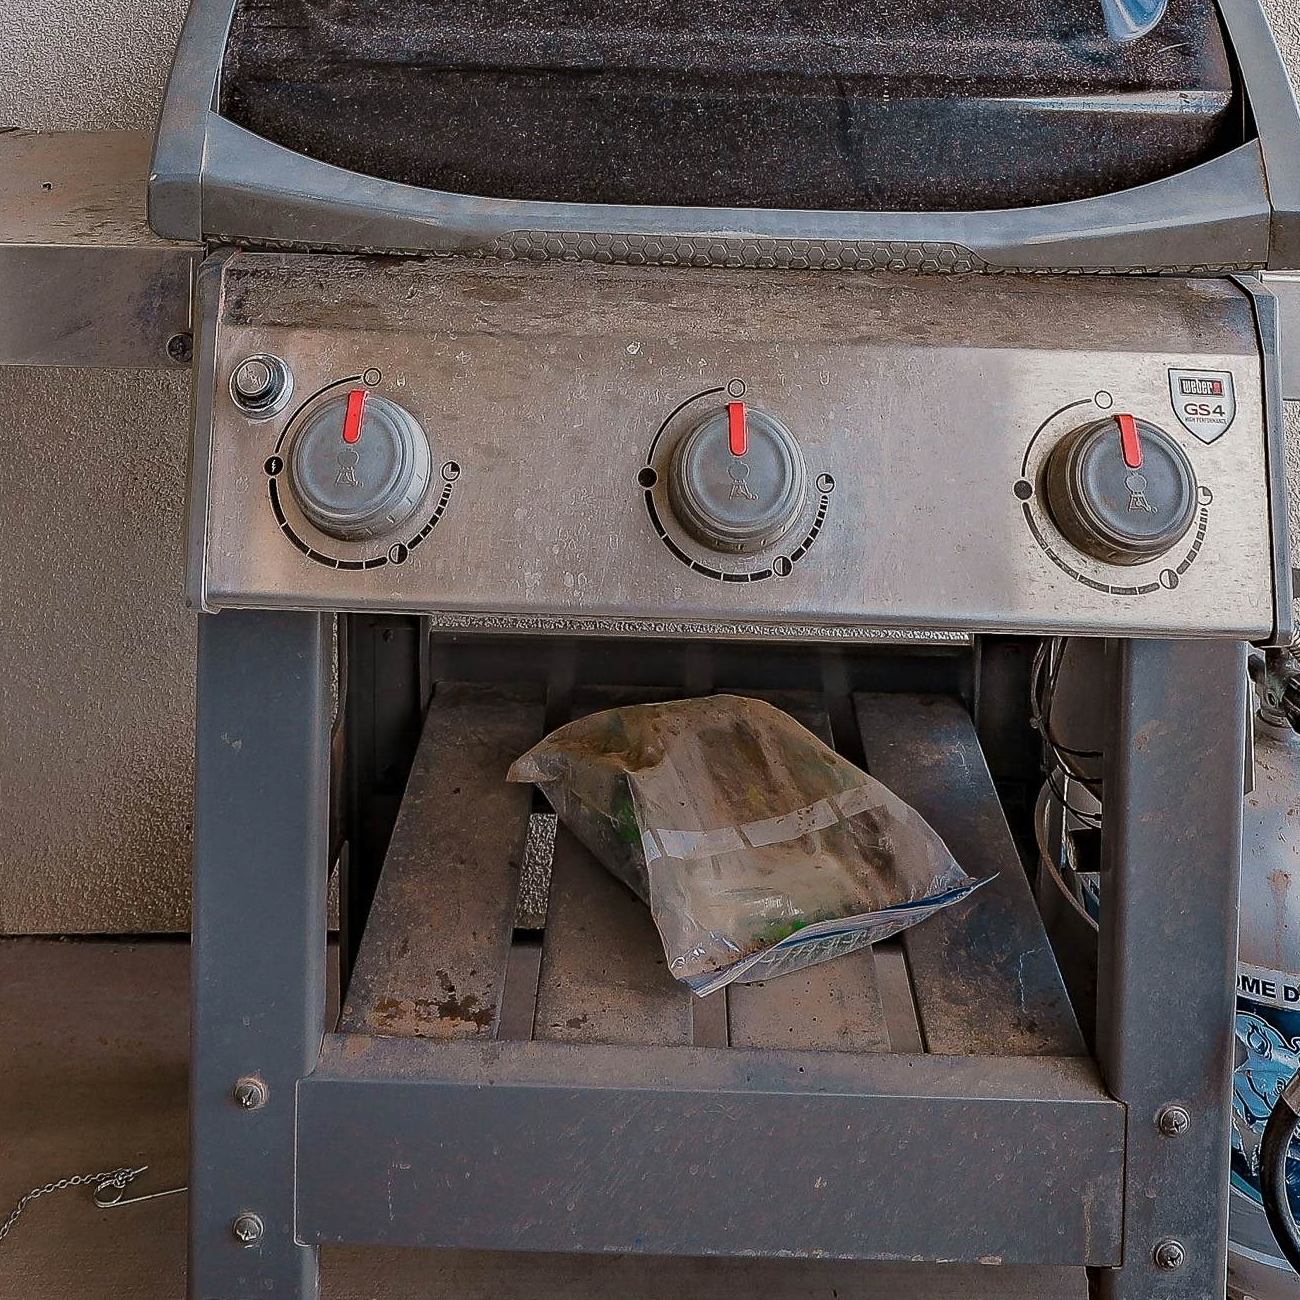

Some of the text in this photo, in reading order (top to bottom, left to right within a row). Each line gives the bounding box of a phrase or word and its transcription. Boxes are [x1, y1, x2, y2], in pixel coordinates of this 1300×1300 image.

[1181, 379, 1213, 394] weber
[1183, 402, 1226, 417] GS4
[1237, 974, 1277, 999] ME
